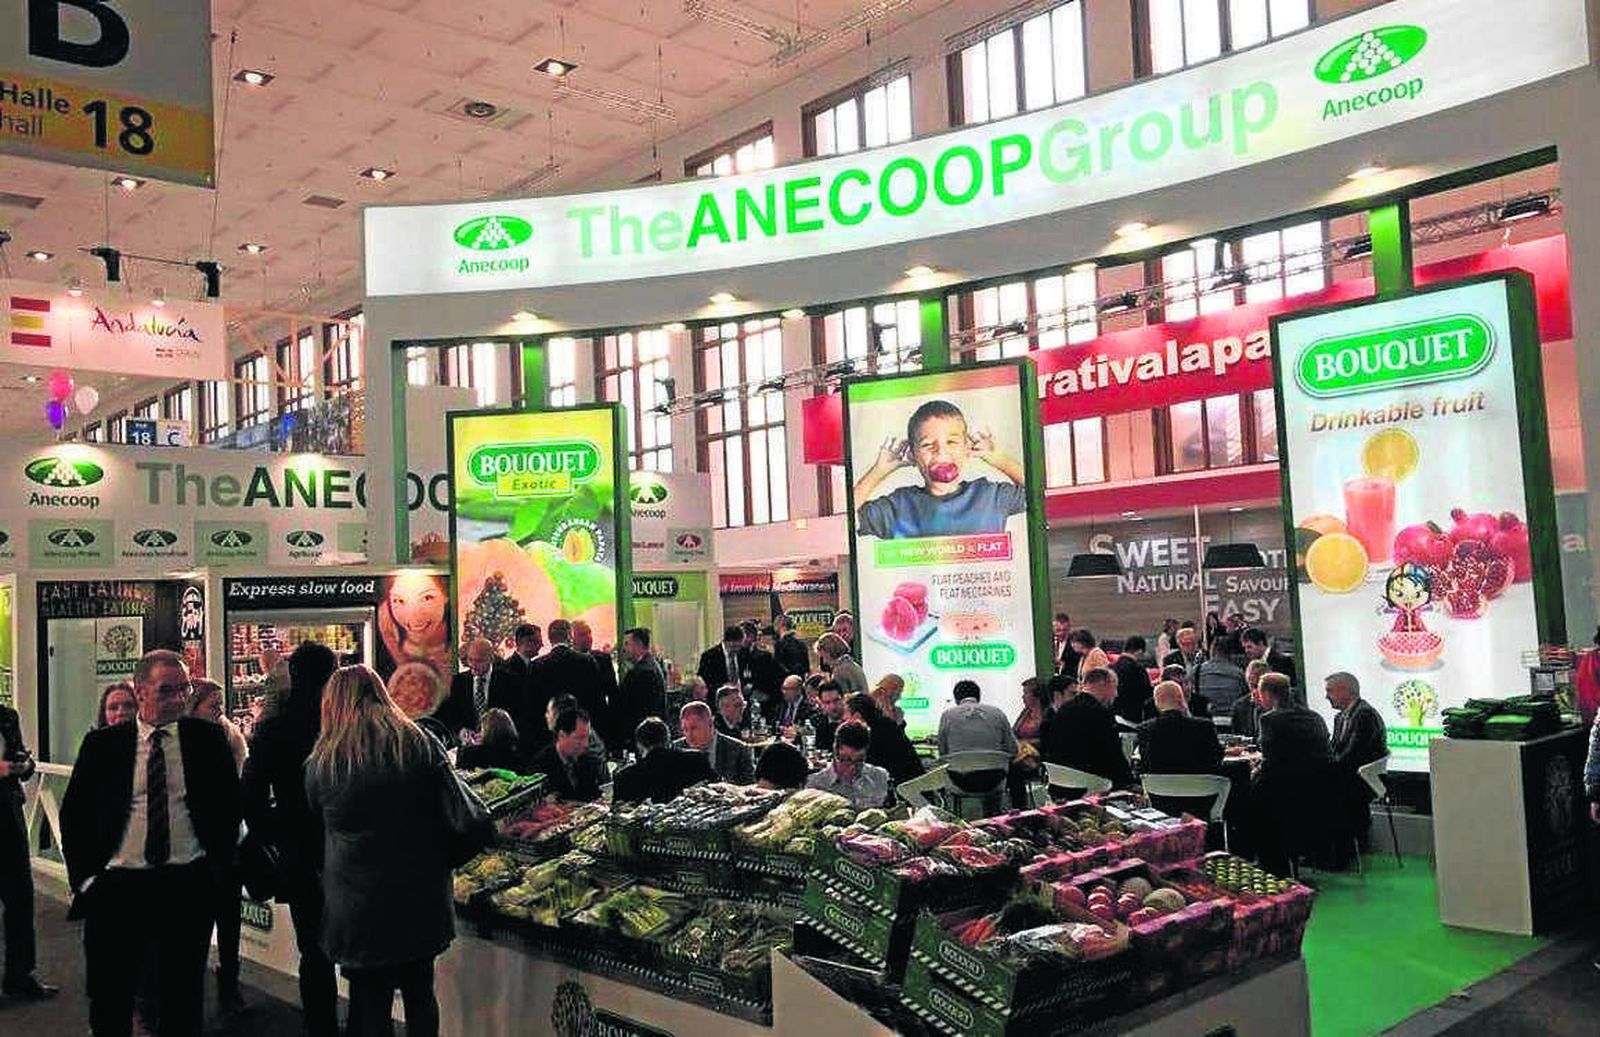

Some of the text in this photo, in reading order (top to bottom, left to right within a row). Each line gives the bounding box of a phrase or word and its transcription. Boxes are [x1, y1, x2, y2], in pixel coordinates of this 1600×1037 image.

[1321, 75, 1424, 122] Anecoop
[0, 79, 155, 155] Halle 18
[0, 107, 43, 137] hall
[458, 256, 530, 275] Anecoop
[1314, 328, 1474, 382] BOUQUET
[1309, 391, 1486, 433] Drinkable fruit
[132, 431, 152, 446] 18
[480, 450, 590, 477] BOUQUET
[136, 461, 367, 508] TheANE
[511, 477, 557, 491] Exotic
[28, 491, 101, 510] Anecoop
[228, 579, 376, 600] Express slow food
[1116, 570, 1218, 594] NATURAL
[1203, 594, 1281, 622] EASY
[936, 647, 1010, 665] BOUQUET
